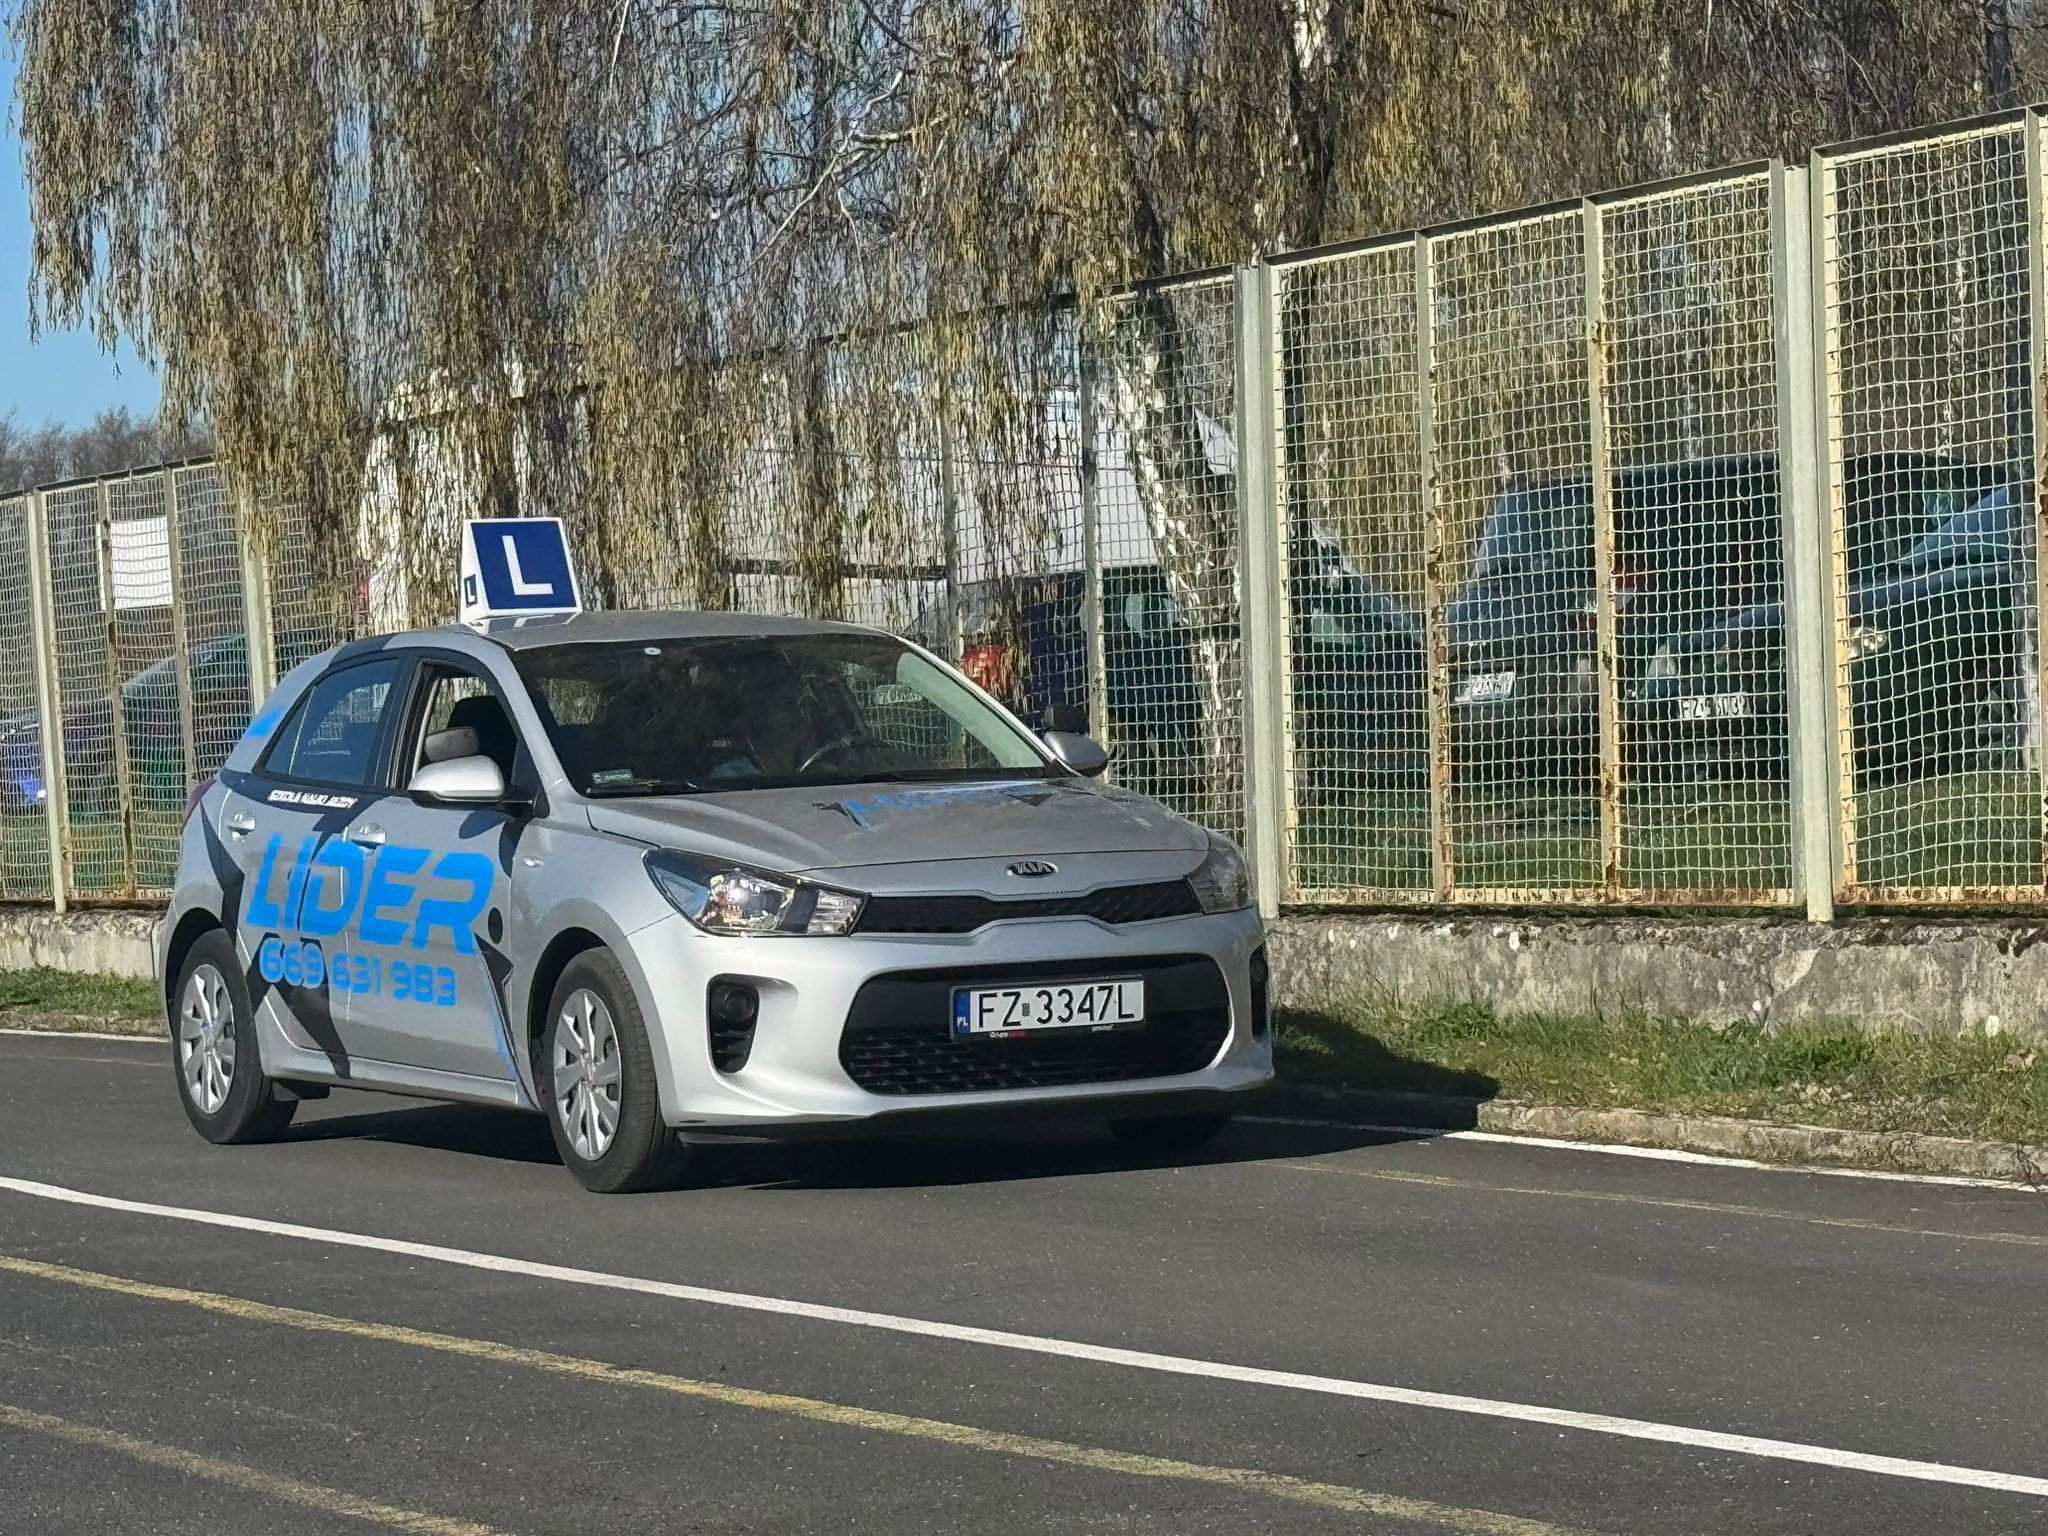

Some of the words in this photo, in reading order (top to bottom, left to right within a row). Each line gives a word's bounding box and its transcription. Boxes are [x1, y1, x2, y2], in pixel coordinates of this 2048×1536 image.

[502, 535, 554, 595] L
[466, 580, 476, 603] L
[1012, 860, 1053, 876] KIA
[246, 833, 495, 957] LIDER
[259, 938, 325, 989] 669
[332, 952, 382, 995] 631
[391, 959, 457, 1007] 983
[956, 1015, 969, 1028] PL
[978, 991, 1022, 1029] FZ
[1035, 984, 1135, 1025] 3347L
